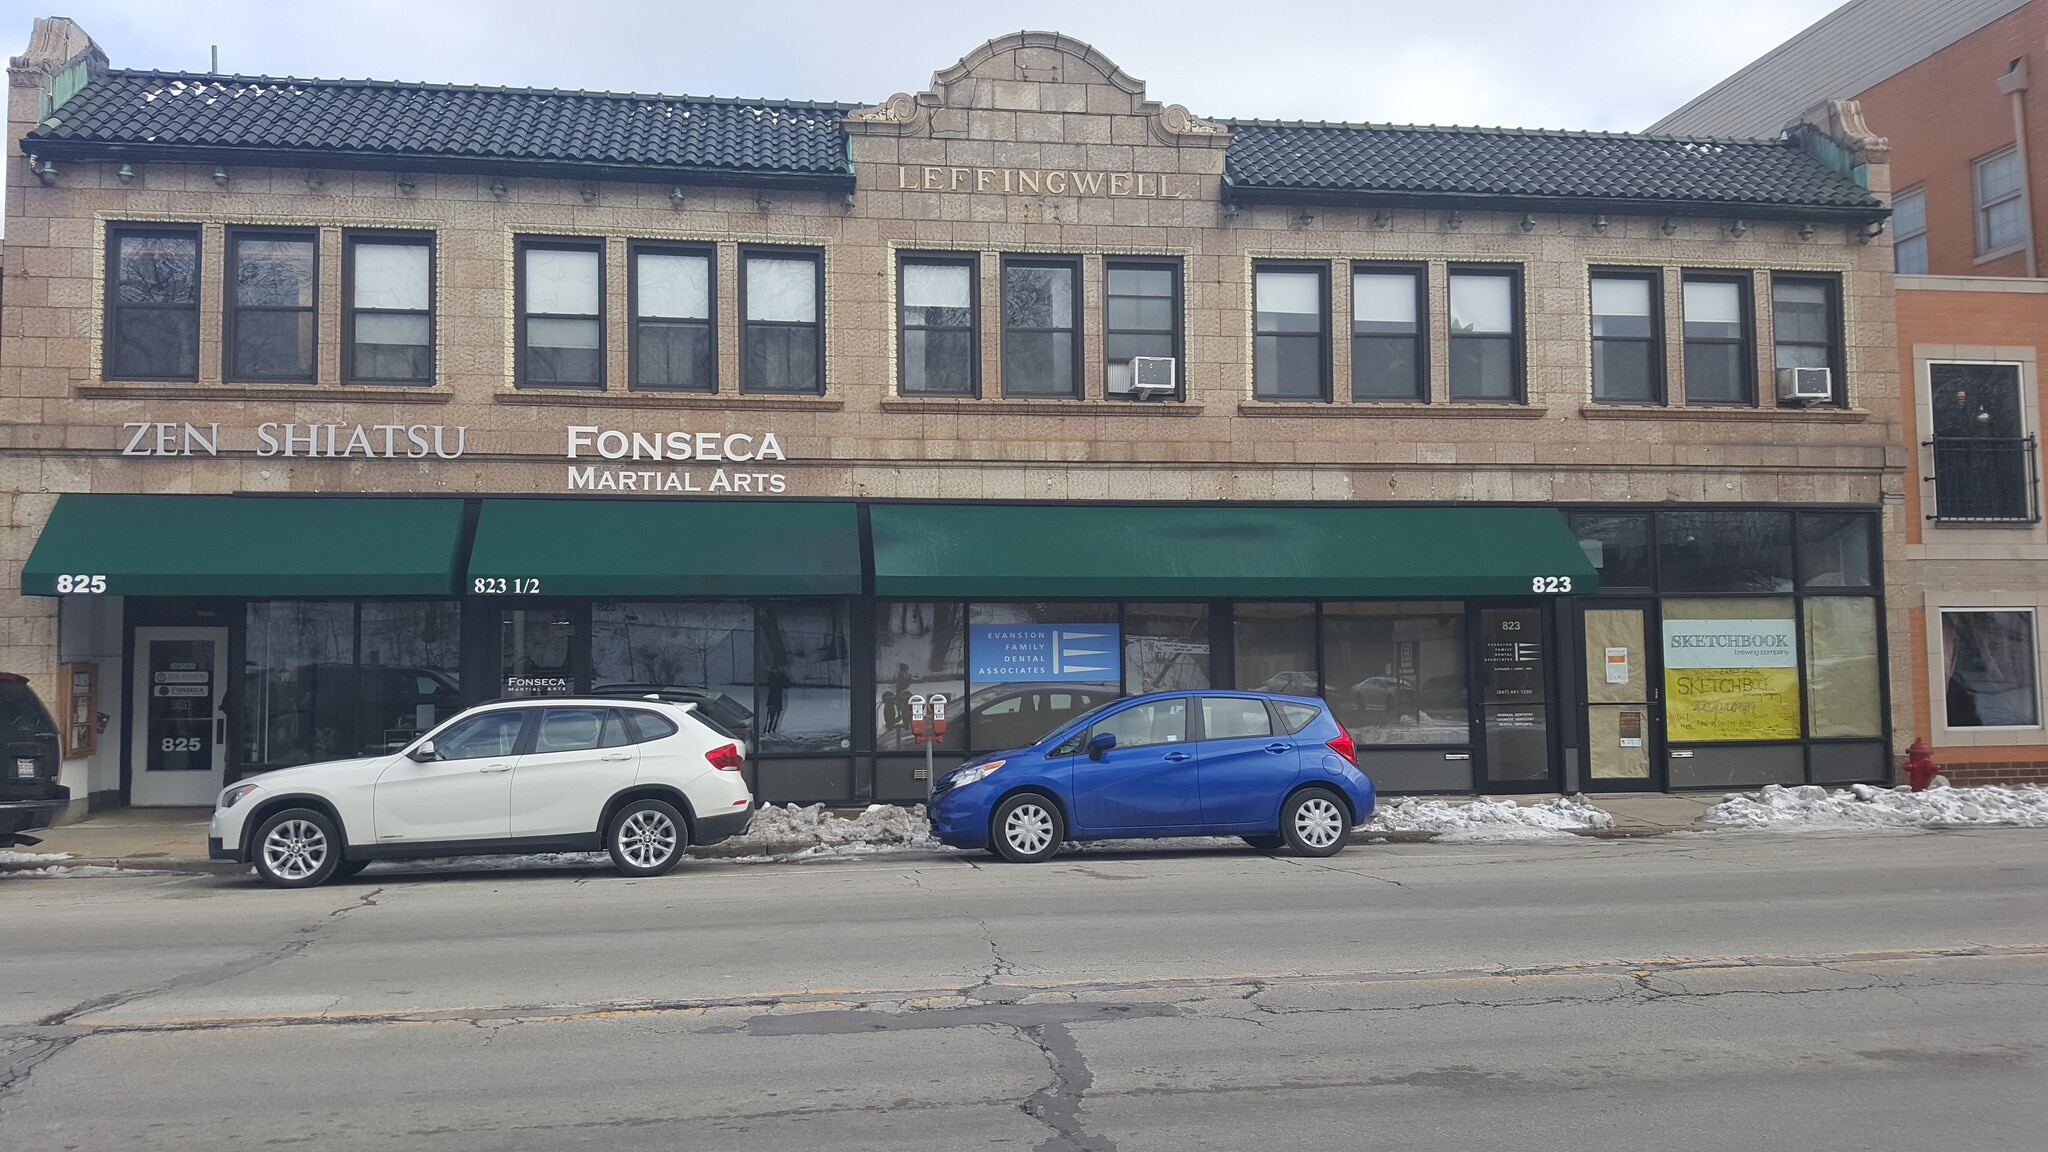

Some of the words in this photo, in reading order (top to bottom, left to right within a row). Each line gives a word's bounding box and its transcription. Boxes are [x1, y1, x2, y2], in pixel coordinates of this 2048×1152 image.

[899, 166, 1182, 198] LEFFINGWELL
[121, 422, 220, 457] ZEN
[256, 422, 467, 459] SHIATSU
[567, 425, 787, 462] FONSECA
[567, 466, 701, 491] MARTIAL
[708, 468, 786, 493] ARTS
[57, 574, 107, 593] 825
[474, 577, 507, 594] 823
[513, 578, 540, 594] 1/2
[1532, 576, 1572, 593] 823
[1502, 621, 1520, 630] 823
[1671, 634, 1789, 648] SKETCHBOOK
[508, 677, 566, 686] FONSECA
[161, 737, 202, 752] 825
